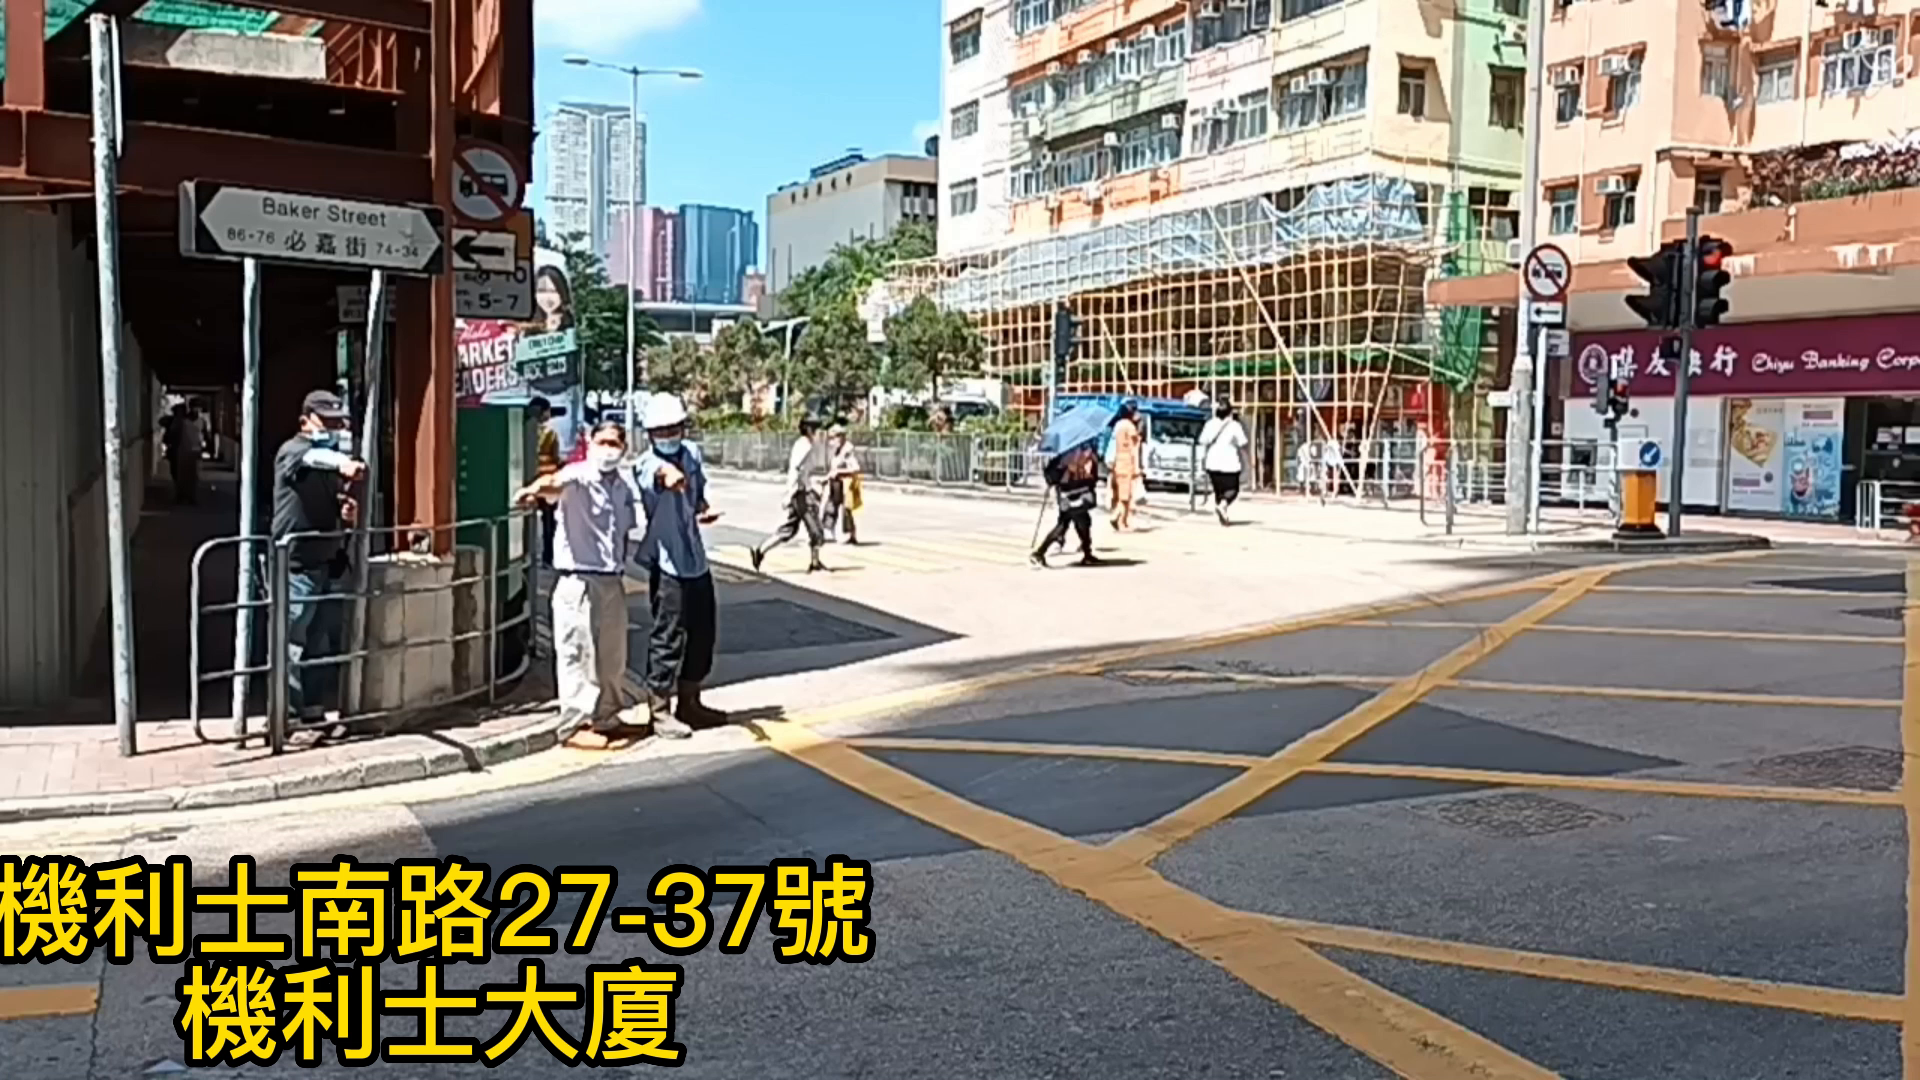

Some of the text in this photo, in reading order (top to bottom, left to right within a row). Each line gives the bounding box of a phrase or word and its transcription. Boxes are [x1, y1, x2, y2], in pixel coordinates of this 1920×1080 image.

[262, 197, 387, 228] Baker Street
[227, 227, 419, 258] 86-76 必嘉街 74-34
[456, 332, 516, 369] ARKET
[1752, 352, 1795, 374] Chiyu
[1801, 349, 1870, 372] Banking
[455, 360, 519, 395] EADERS
